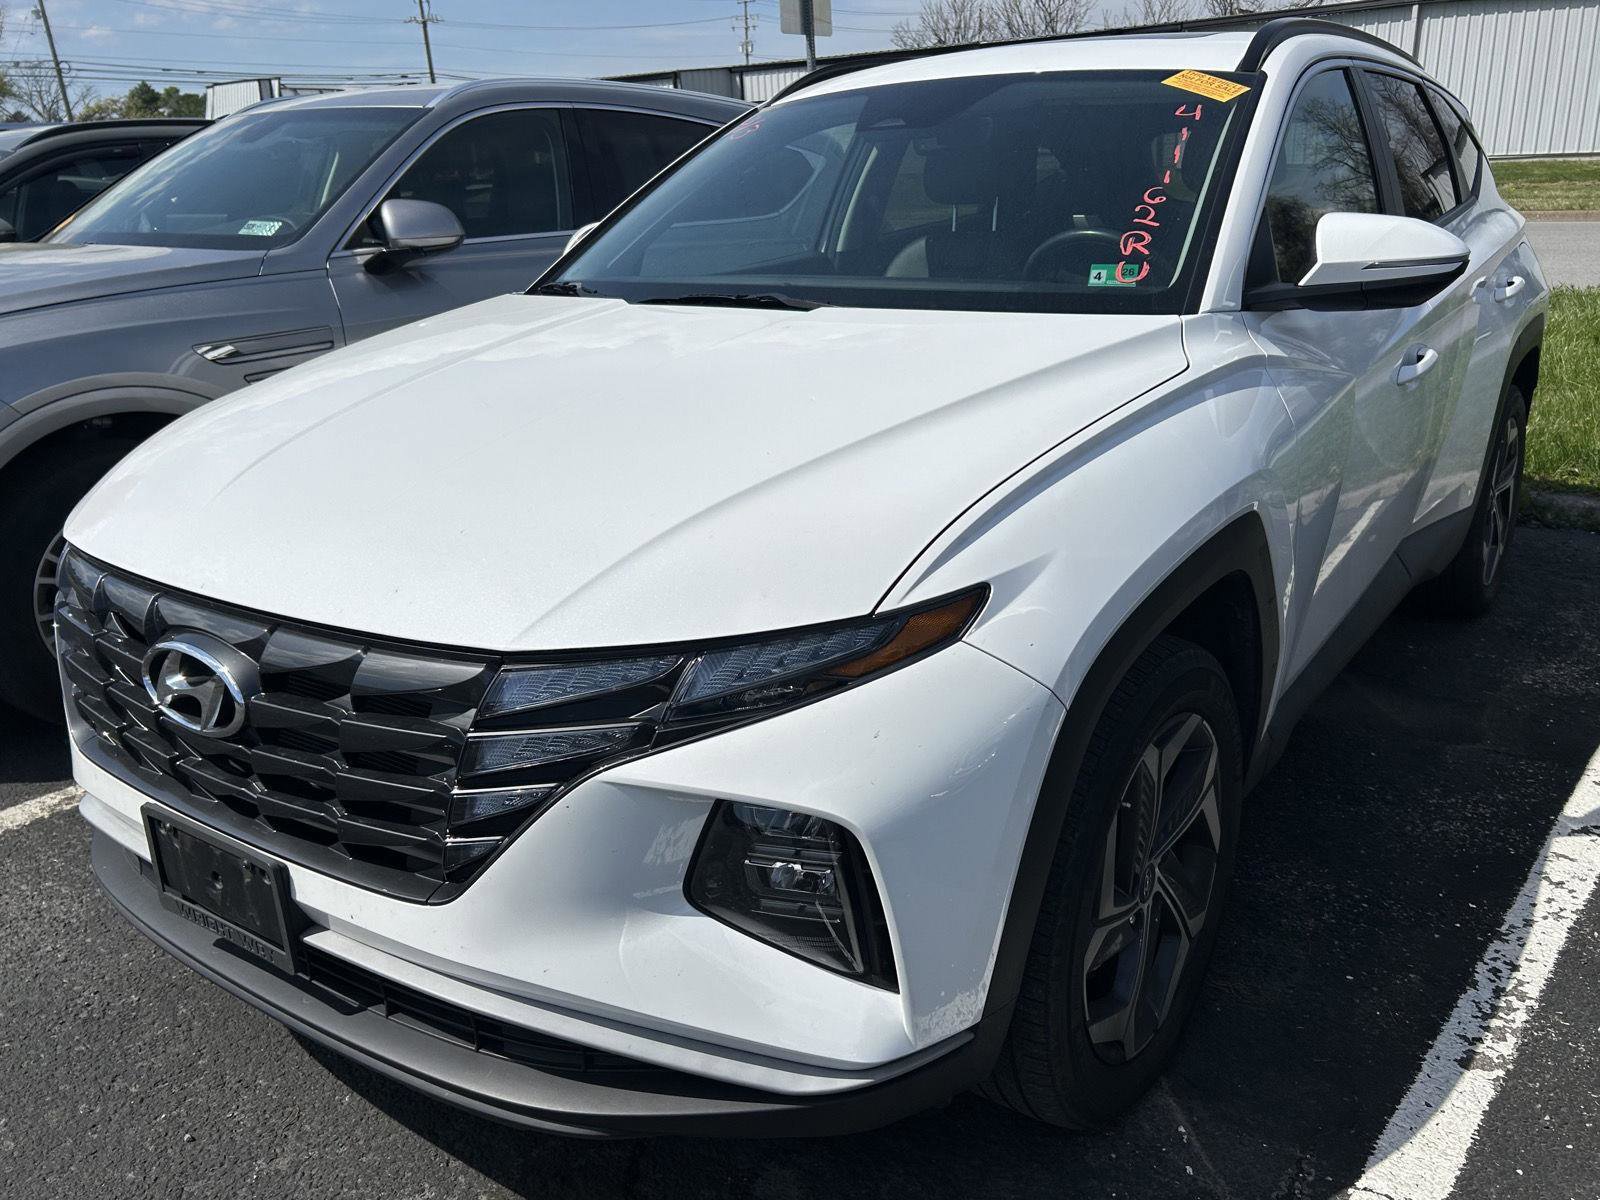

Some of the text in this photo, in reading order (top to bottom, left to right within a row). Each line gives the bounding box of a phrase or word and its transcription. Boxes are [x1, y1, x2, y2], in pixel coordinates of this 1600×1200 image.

[1194, 77, 1215, 87] FOR
[1213, 83, 1238, 95] SALE
[1093, 268, 1135, 281] 4 26
[175, 899, 277, 964] WRIGHT WAY
